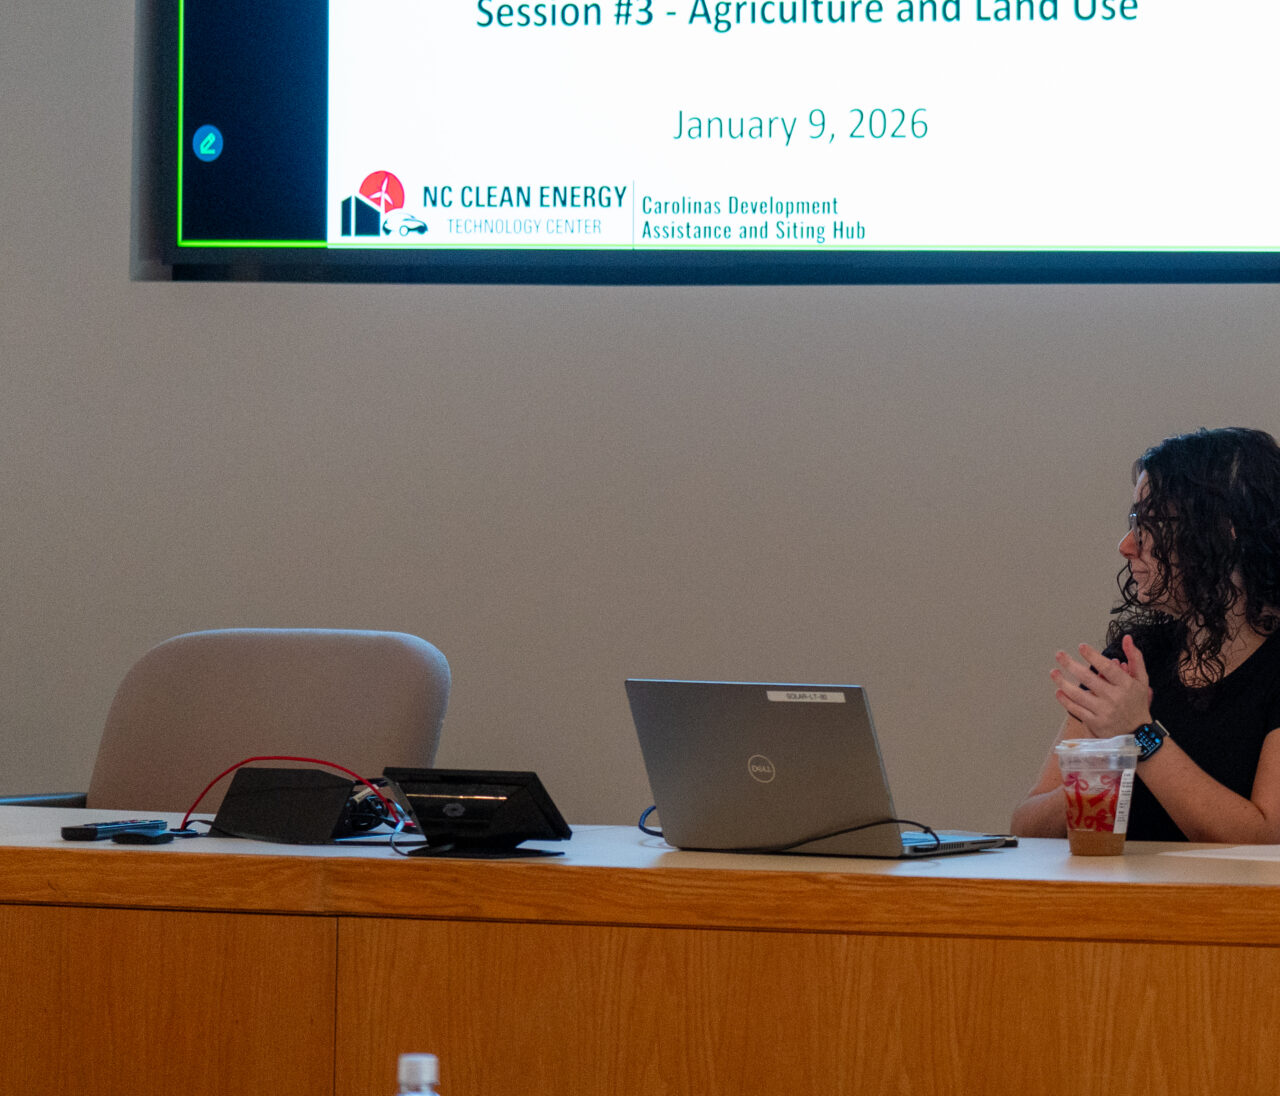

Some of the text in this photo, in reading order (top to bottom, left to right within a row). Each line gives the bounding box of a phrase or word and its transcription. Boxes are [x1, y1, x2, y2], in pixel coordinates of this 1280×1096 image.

[673, 108, 928, 146] January 9, 2026
[424, 186, 627, 208] NC CLEAN ENERGY
[642, 196, 838, 219] Carolinas Development
[447, 218, 602, 235] TECHNOLOGY CENTER
[642, 221, 865, 243] Assistance and Siting Hub
